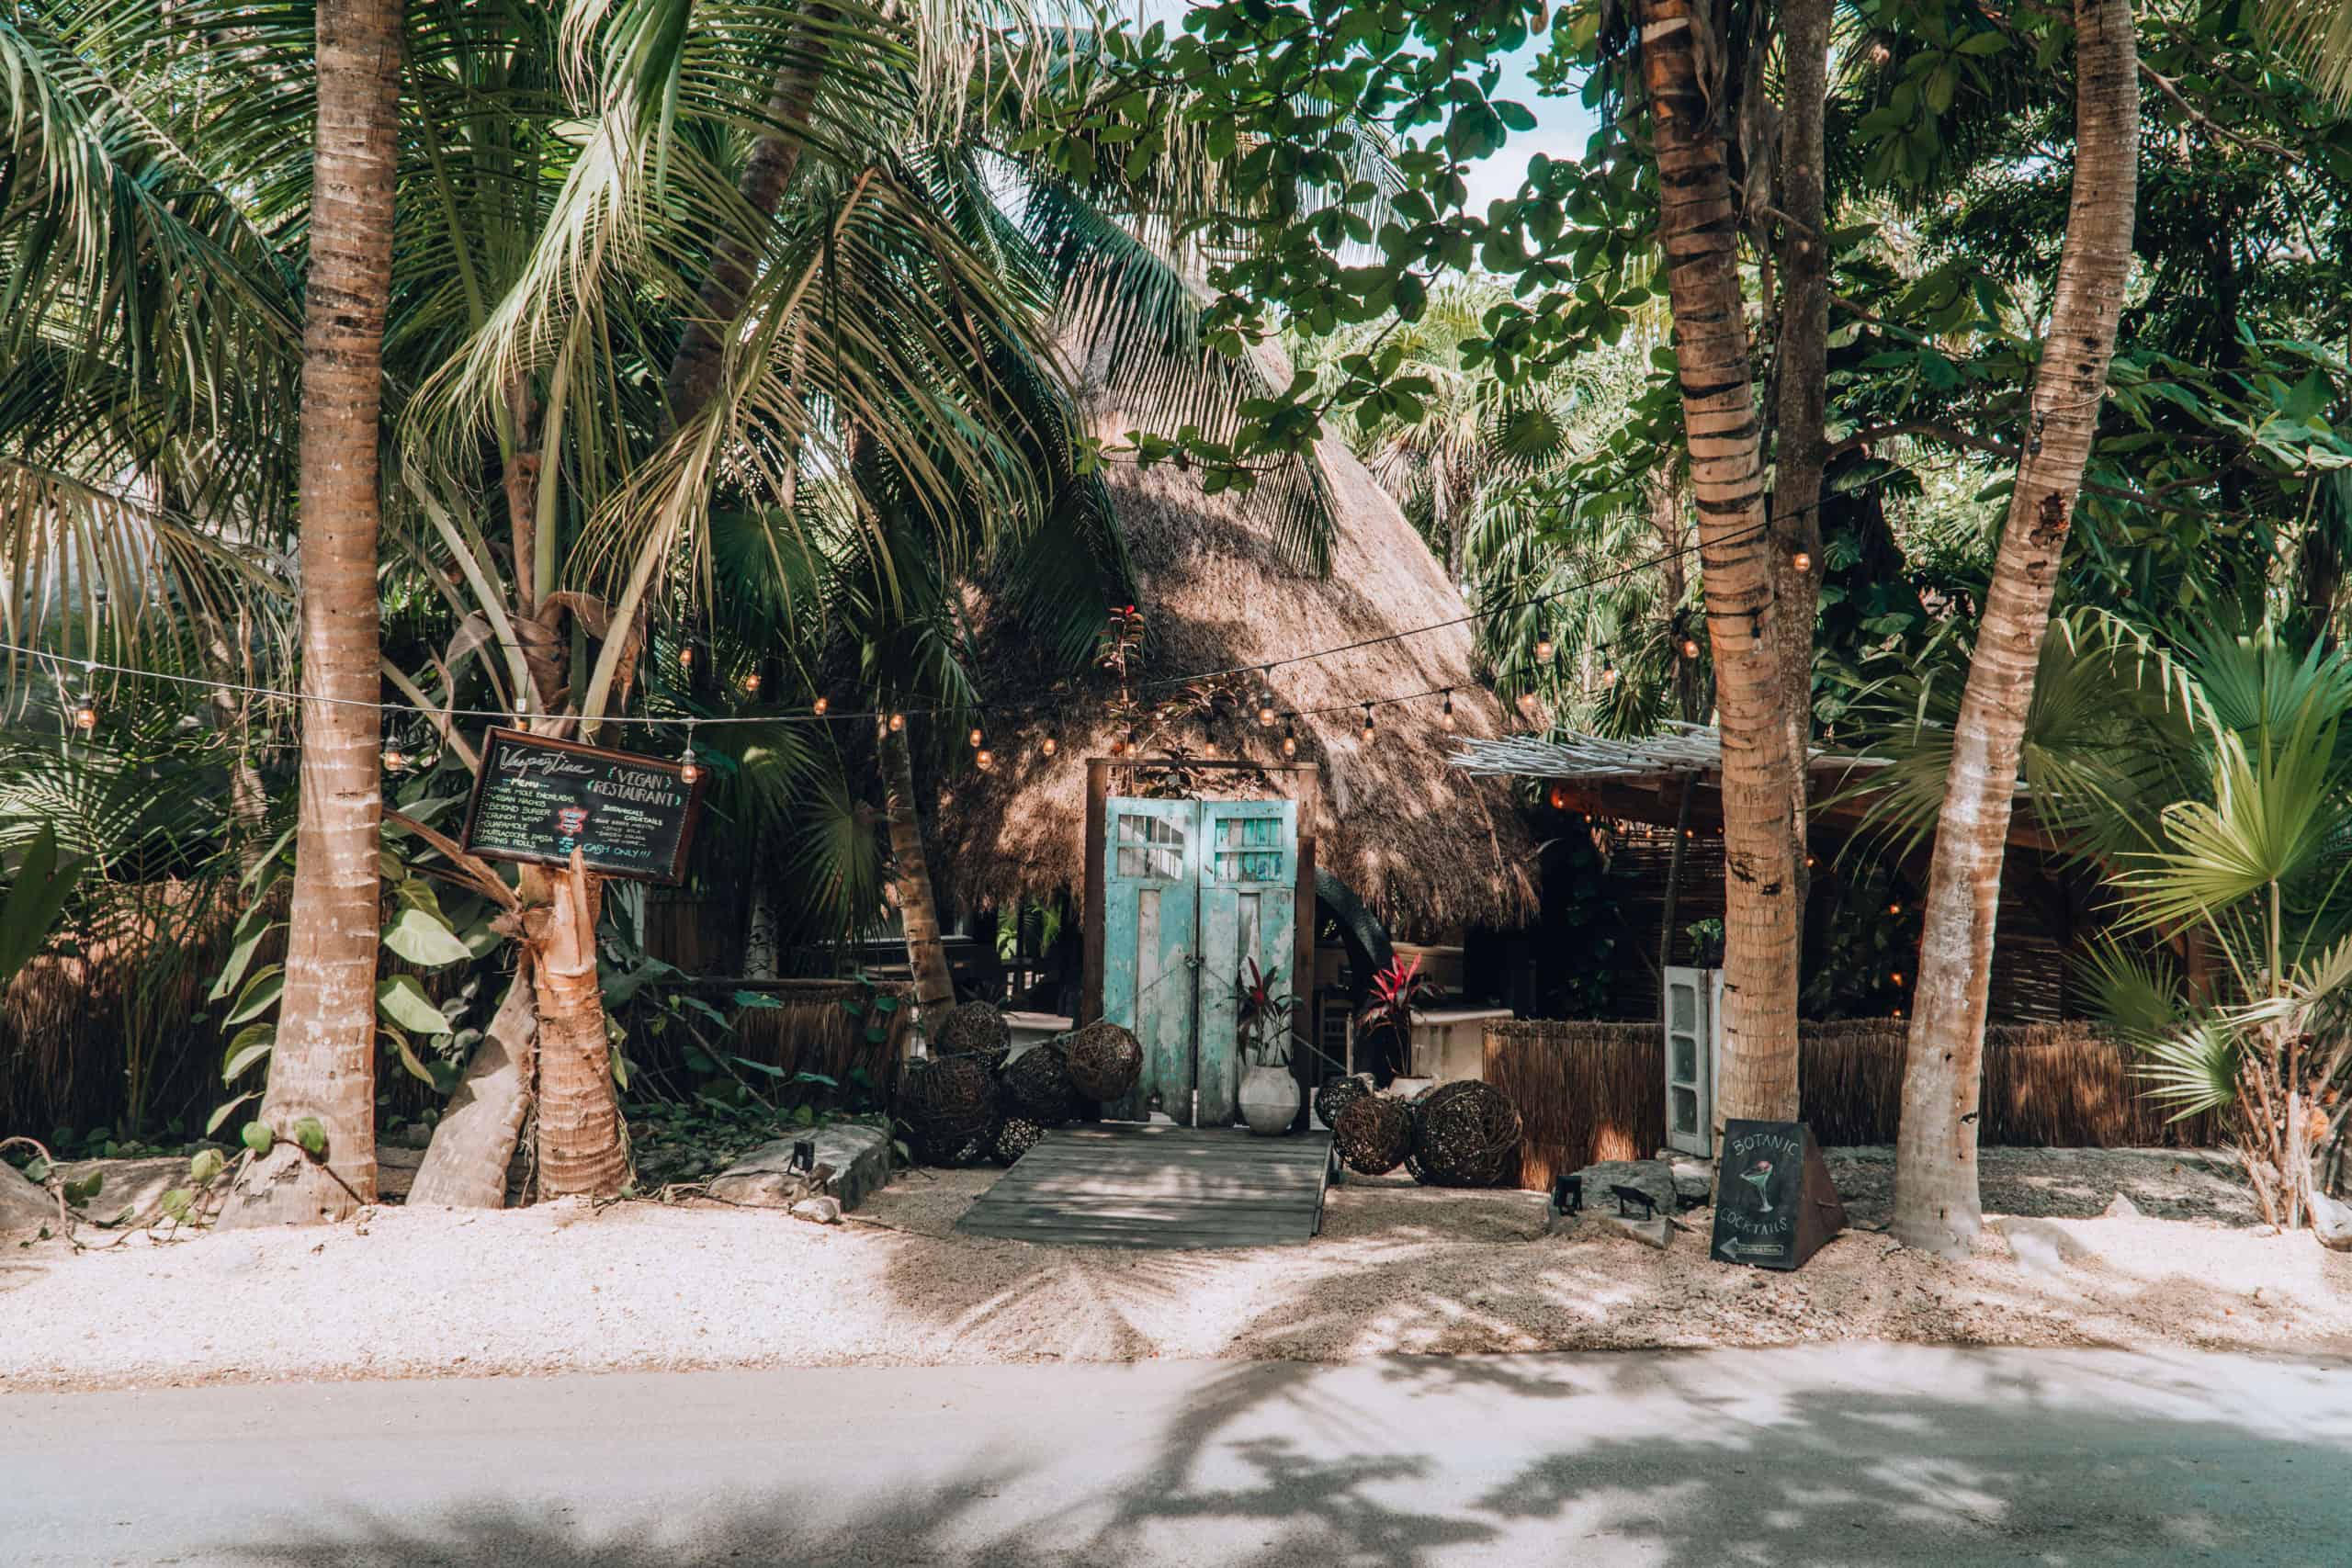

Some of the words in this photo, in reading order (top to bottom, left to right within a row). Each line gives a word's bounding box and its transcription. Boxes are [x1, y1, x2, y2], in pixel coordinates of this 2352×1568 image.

[511, 778, 539, 788] MENU
[617, 769, 662, 789] VEGAN
[491, 794, 516, 803] VEGAN
[593, 780, 675, 807] RESTAURANT
[583, 843, 610, 854] CASH
[1732, 1133, 1799, 1156] BOTANIC
[1720, 1207, 1787, 1235] COCKTAILS
